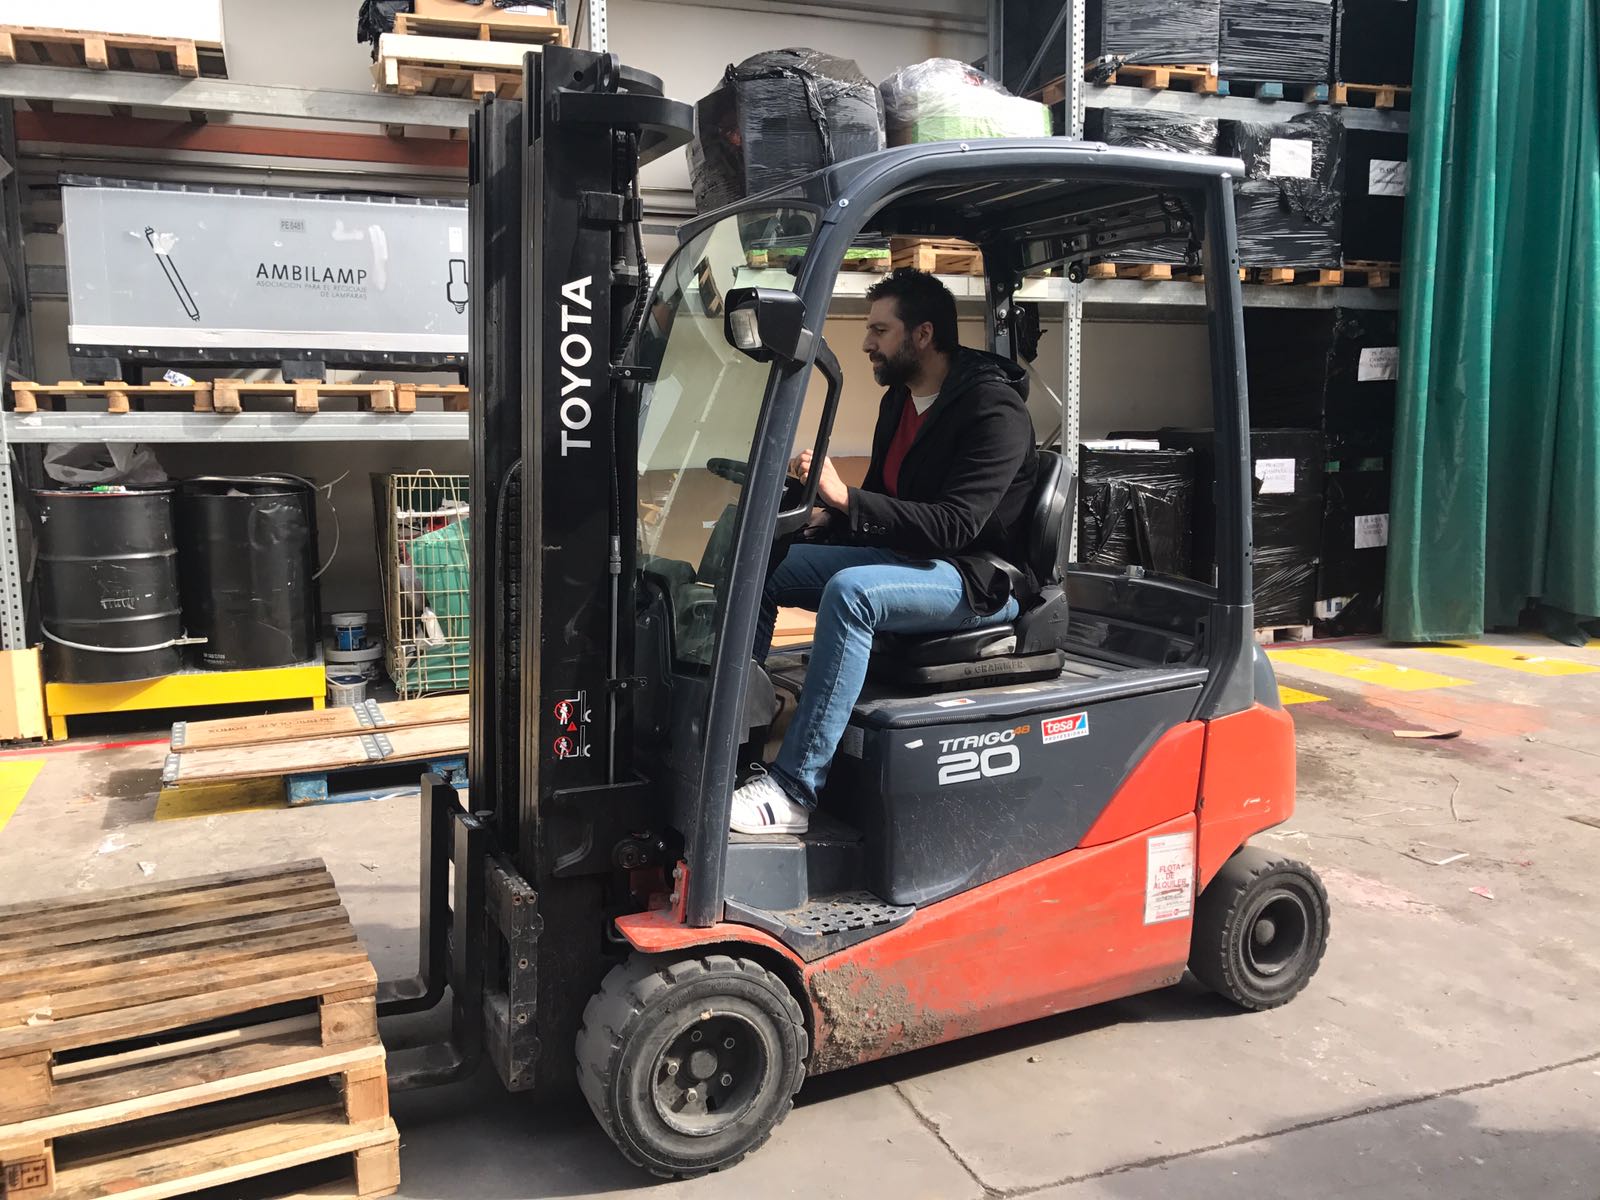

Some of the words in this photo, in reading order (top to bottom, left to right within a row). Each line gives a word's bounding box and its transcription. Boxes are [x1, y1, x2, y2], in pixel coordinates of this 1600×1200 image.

[256, 262, 367, 285] AMBILAMP
[560, 275, 592, 457] TOYOTA
[938, 729, 1016, 753] TRAIGO
[1012, 724, 1031, 736] 48
[1045, 719, 1073, 735] tesa
[937, 744, 1021, 786] 20
[1159, 863, 1181, 873] FLOTA
[1165, 872, 1175, 880] DE
